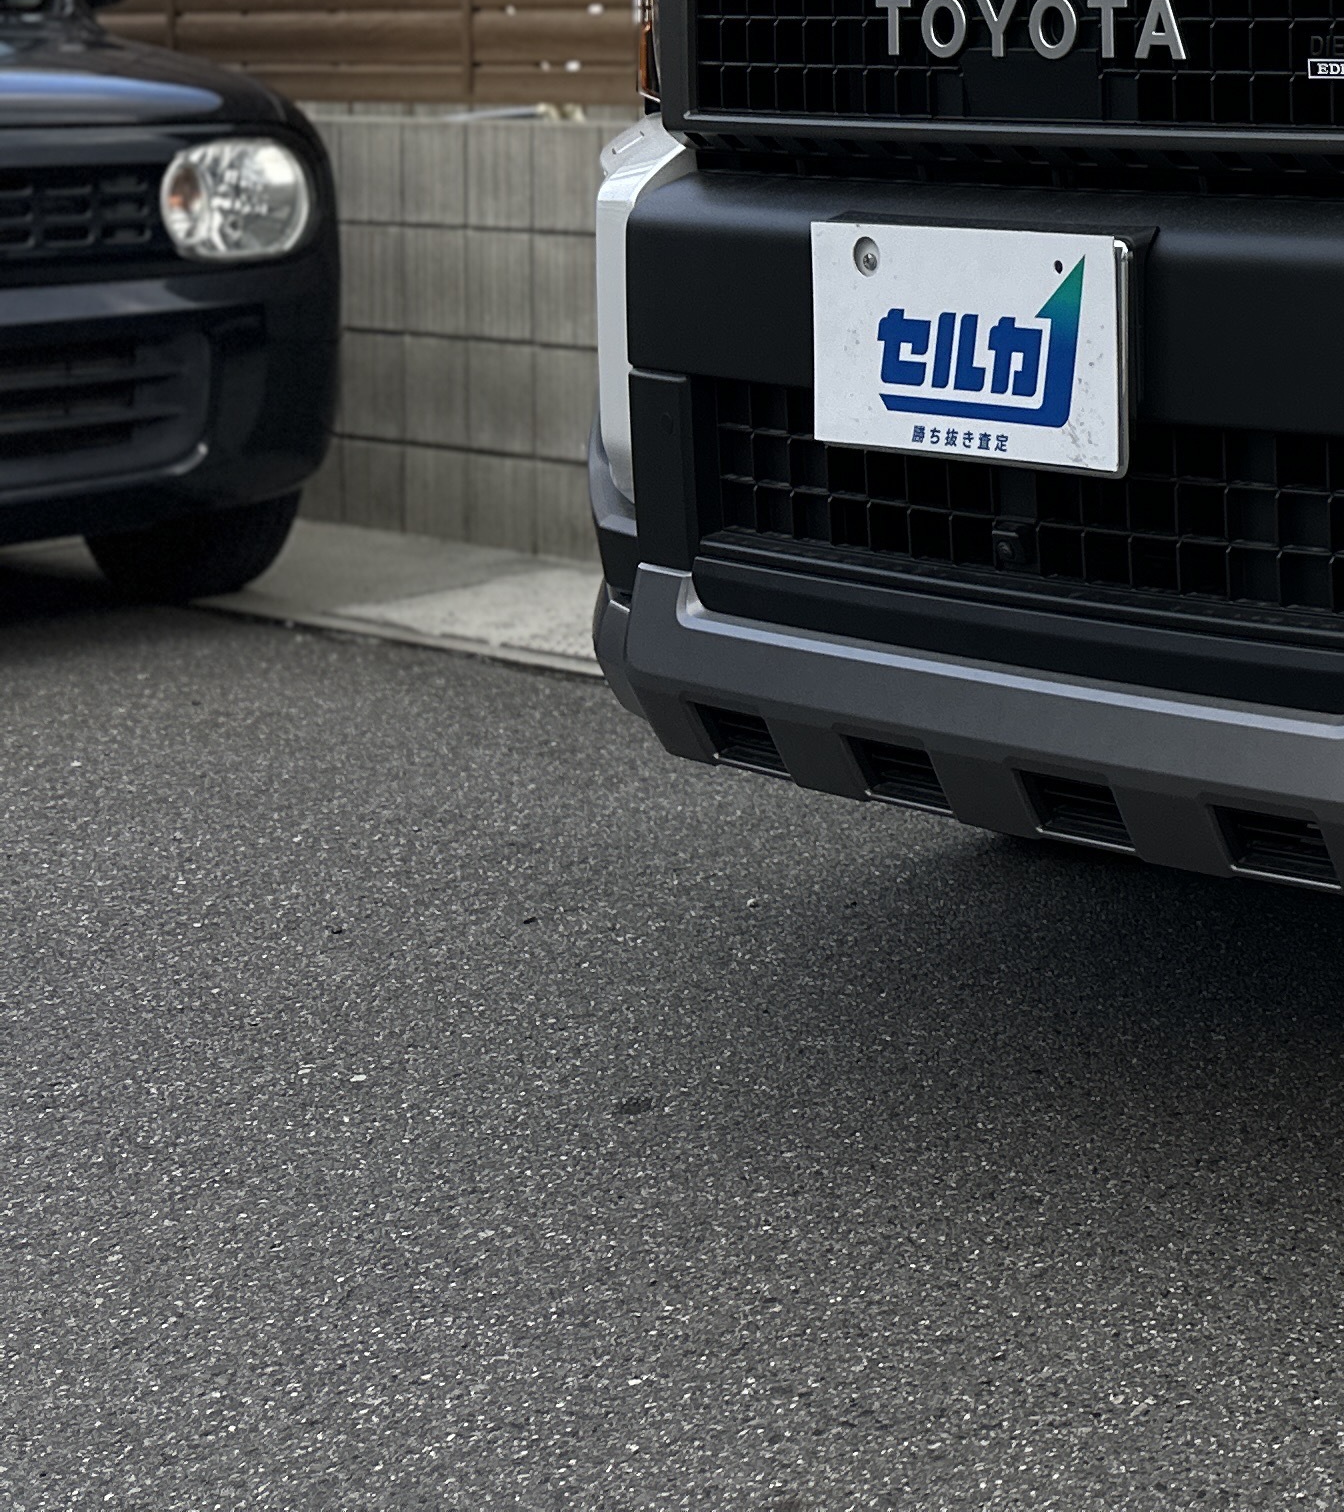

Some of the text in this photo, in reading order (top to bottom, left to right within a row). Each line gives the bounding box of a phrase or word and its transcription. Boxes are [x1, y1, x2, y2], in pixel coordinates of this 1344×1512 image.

[876, 307, 1044, 398] セルカ
[911, 424, 1010, 453] 勝ち抜き査定
